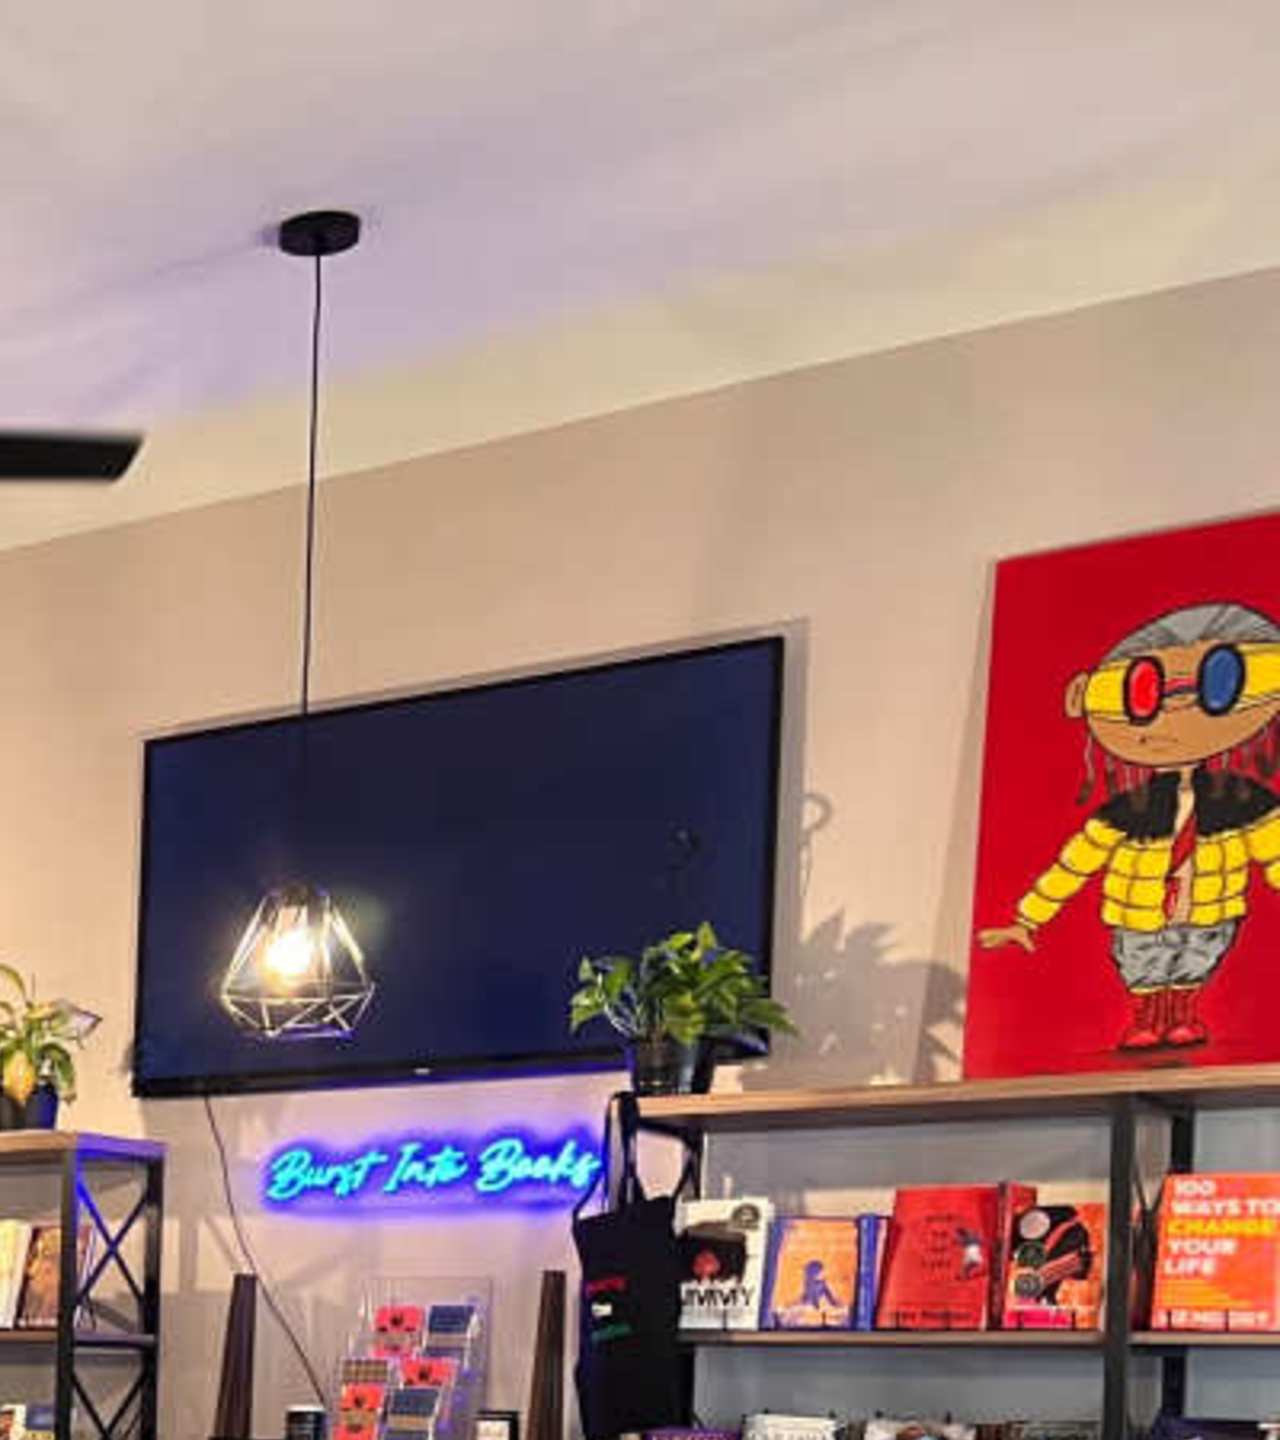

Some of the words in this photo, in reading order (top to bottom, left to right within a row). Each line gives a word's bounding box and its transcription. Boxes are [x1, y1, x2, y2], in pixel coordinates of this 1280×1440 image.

[266, 1150, 388, 1200] Burst
[383, 1142, 469, 1192] Into
[475, 1138, 602, 1192] Books
[1167, 1218, 1276, 1237] CHANGE
[1169, 1238, 1238, 1255] YOUR
[1163, 1258, 1217, 1275] LIFE
